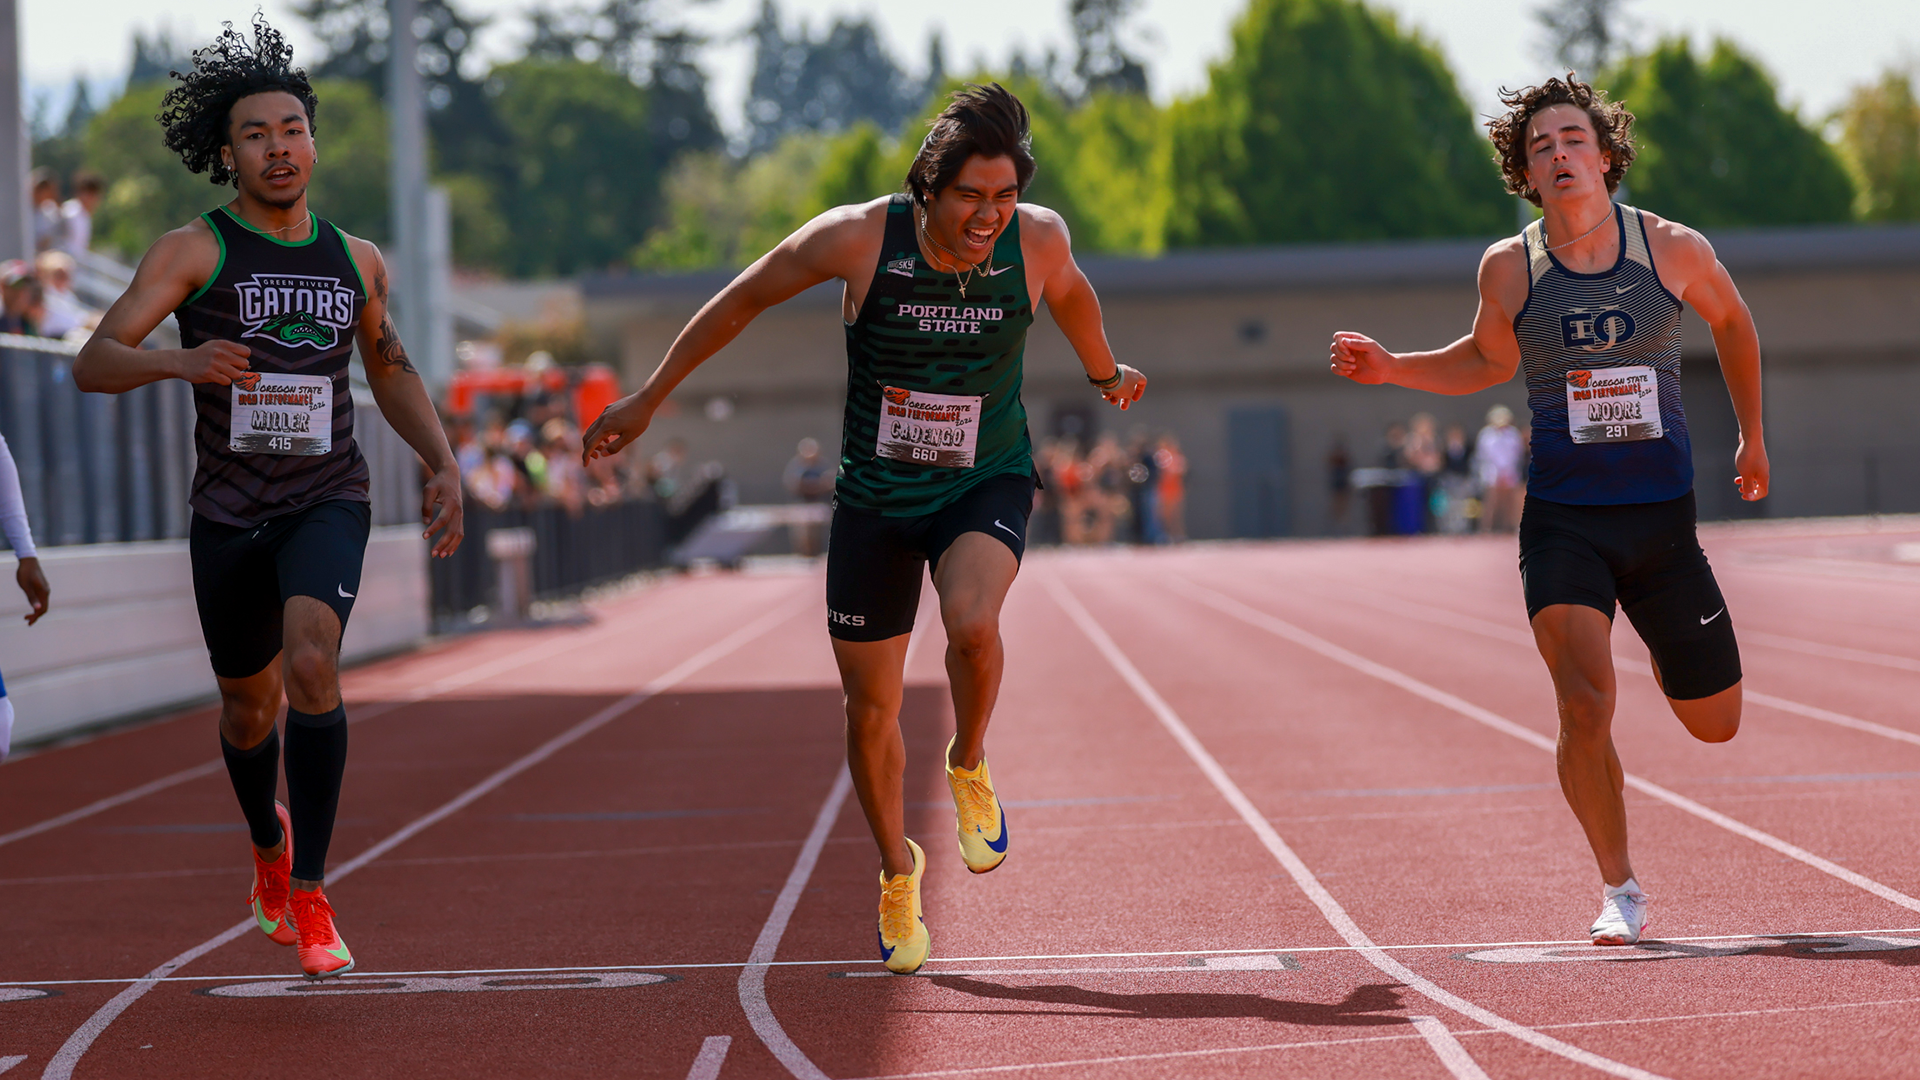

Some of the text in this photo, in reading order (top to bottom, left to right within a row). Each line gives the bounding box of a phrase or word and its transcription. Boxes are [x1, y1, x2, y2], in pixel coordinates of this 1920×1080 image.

[244, 287, 350, 326] GATORS
[897, 304, 1003, 321] PORTLAND
[918, 319, 981, 334] STATE
[1591, 375, 1648, 388] OREGON STATE
[259, 385, 323, 394] OREGON STATE
[1573, 383, 1642, 401] HIGH PERFORMANCE
[238, 394, 313, 407] HIGH PERFORMANCE
[309, 401, 326, 412] 2026
[909, 401, 972, 412] OREGON STATE
[887, 405, 961, 422] HIGH PERFORMANCE
[1588, 402, 1643, 422] MOORE
[250, 410, 310, 433] MILLER
[955, 417, 973, 427] 2026
[890, 420, 965, 447] CADENGO
[1605, 425, 1628, 438] 291
[268, 437, 292, 450] 415
[912, 447, 938, 462] 660
